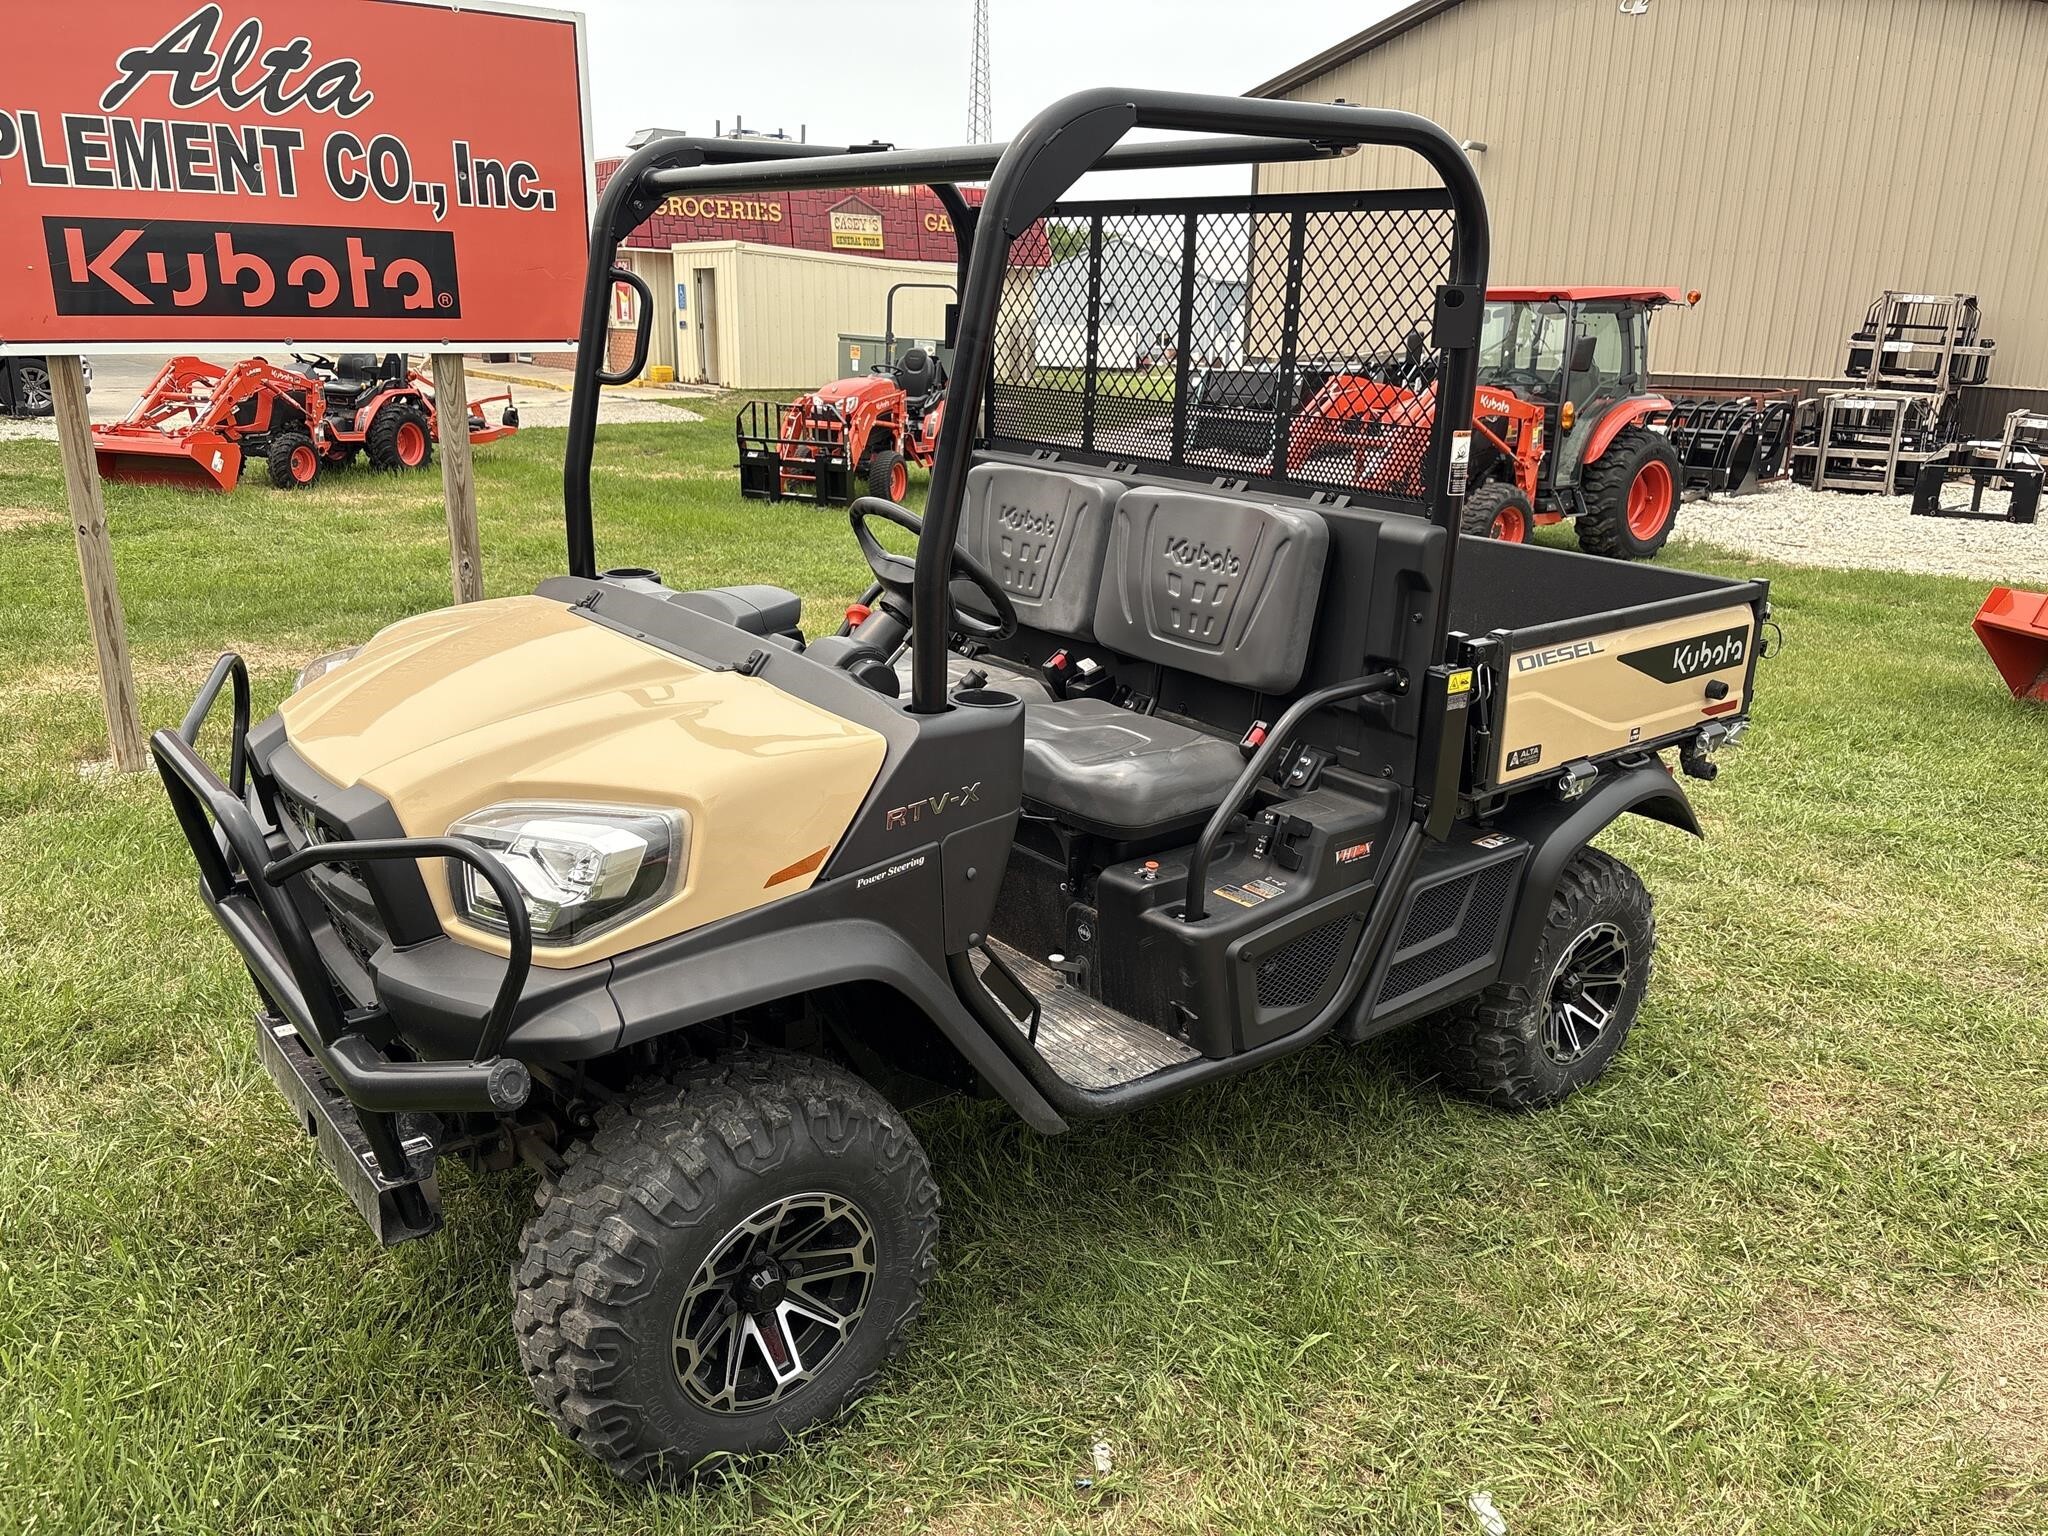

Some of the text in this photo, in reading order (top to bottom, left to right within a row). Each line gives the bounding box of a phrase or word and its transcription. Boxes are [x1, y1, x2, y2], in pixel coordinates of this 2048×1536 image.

[99, 2, 373, 118] Alta
[323, 131, 445, 223] CO.,
[452, 139, 557, 211] Inc.
[833, 215, 880, 232] CASEY'S
[835, 235, 880, 247] GENERAL STORE
[64, 228, 434, 310] Kubota
[1480, 394, 1510, 414] Kubota
[999, 505, 1055, 538] Kubota
[1163, 537, 1241, 577] Kubota
[1516, 640, 1605, 673] DIESEL
[1672, 635, 1744, 675] Kubota
[1520, 746, 1539, 758] ALTA
[886, 781, 982, 831] RTV-X
[856, 856, 925, 889] Power Steering
